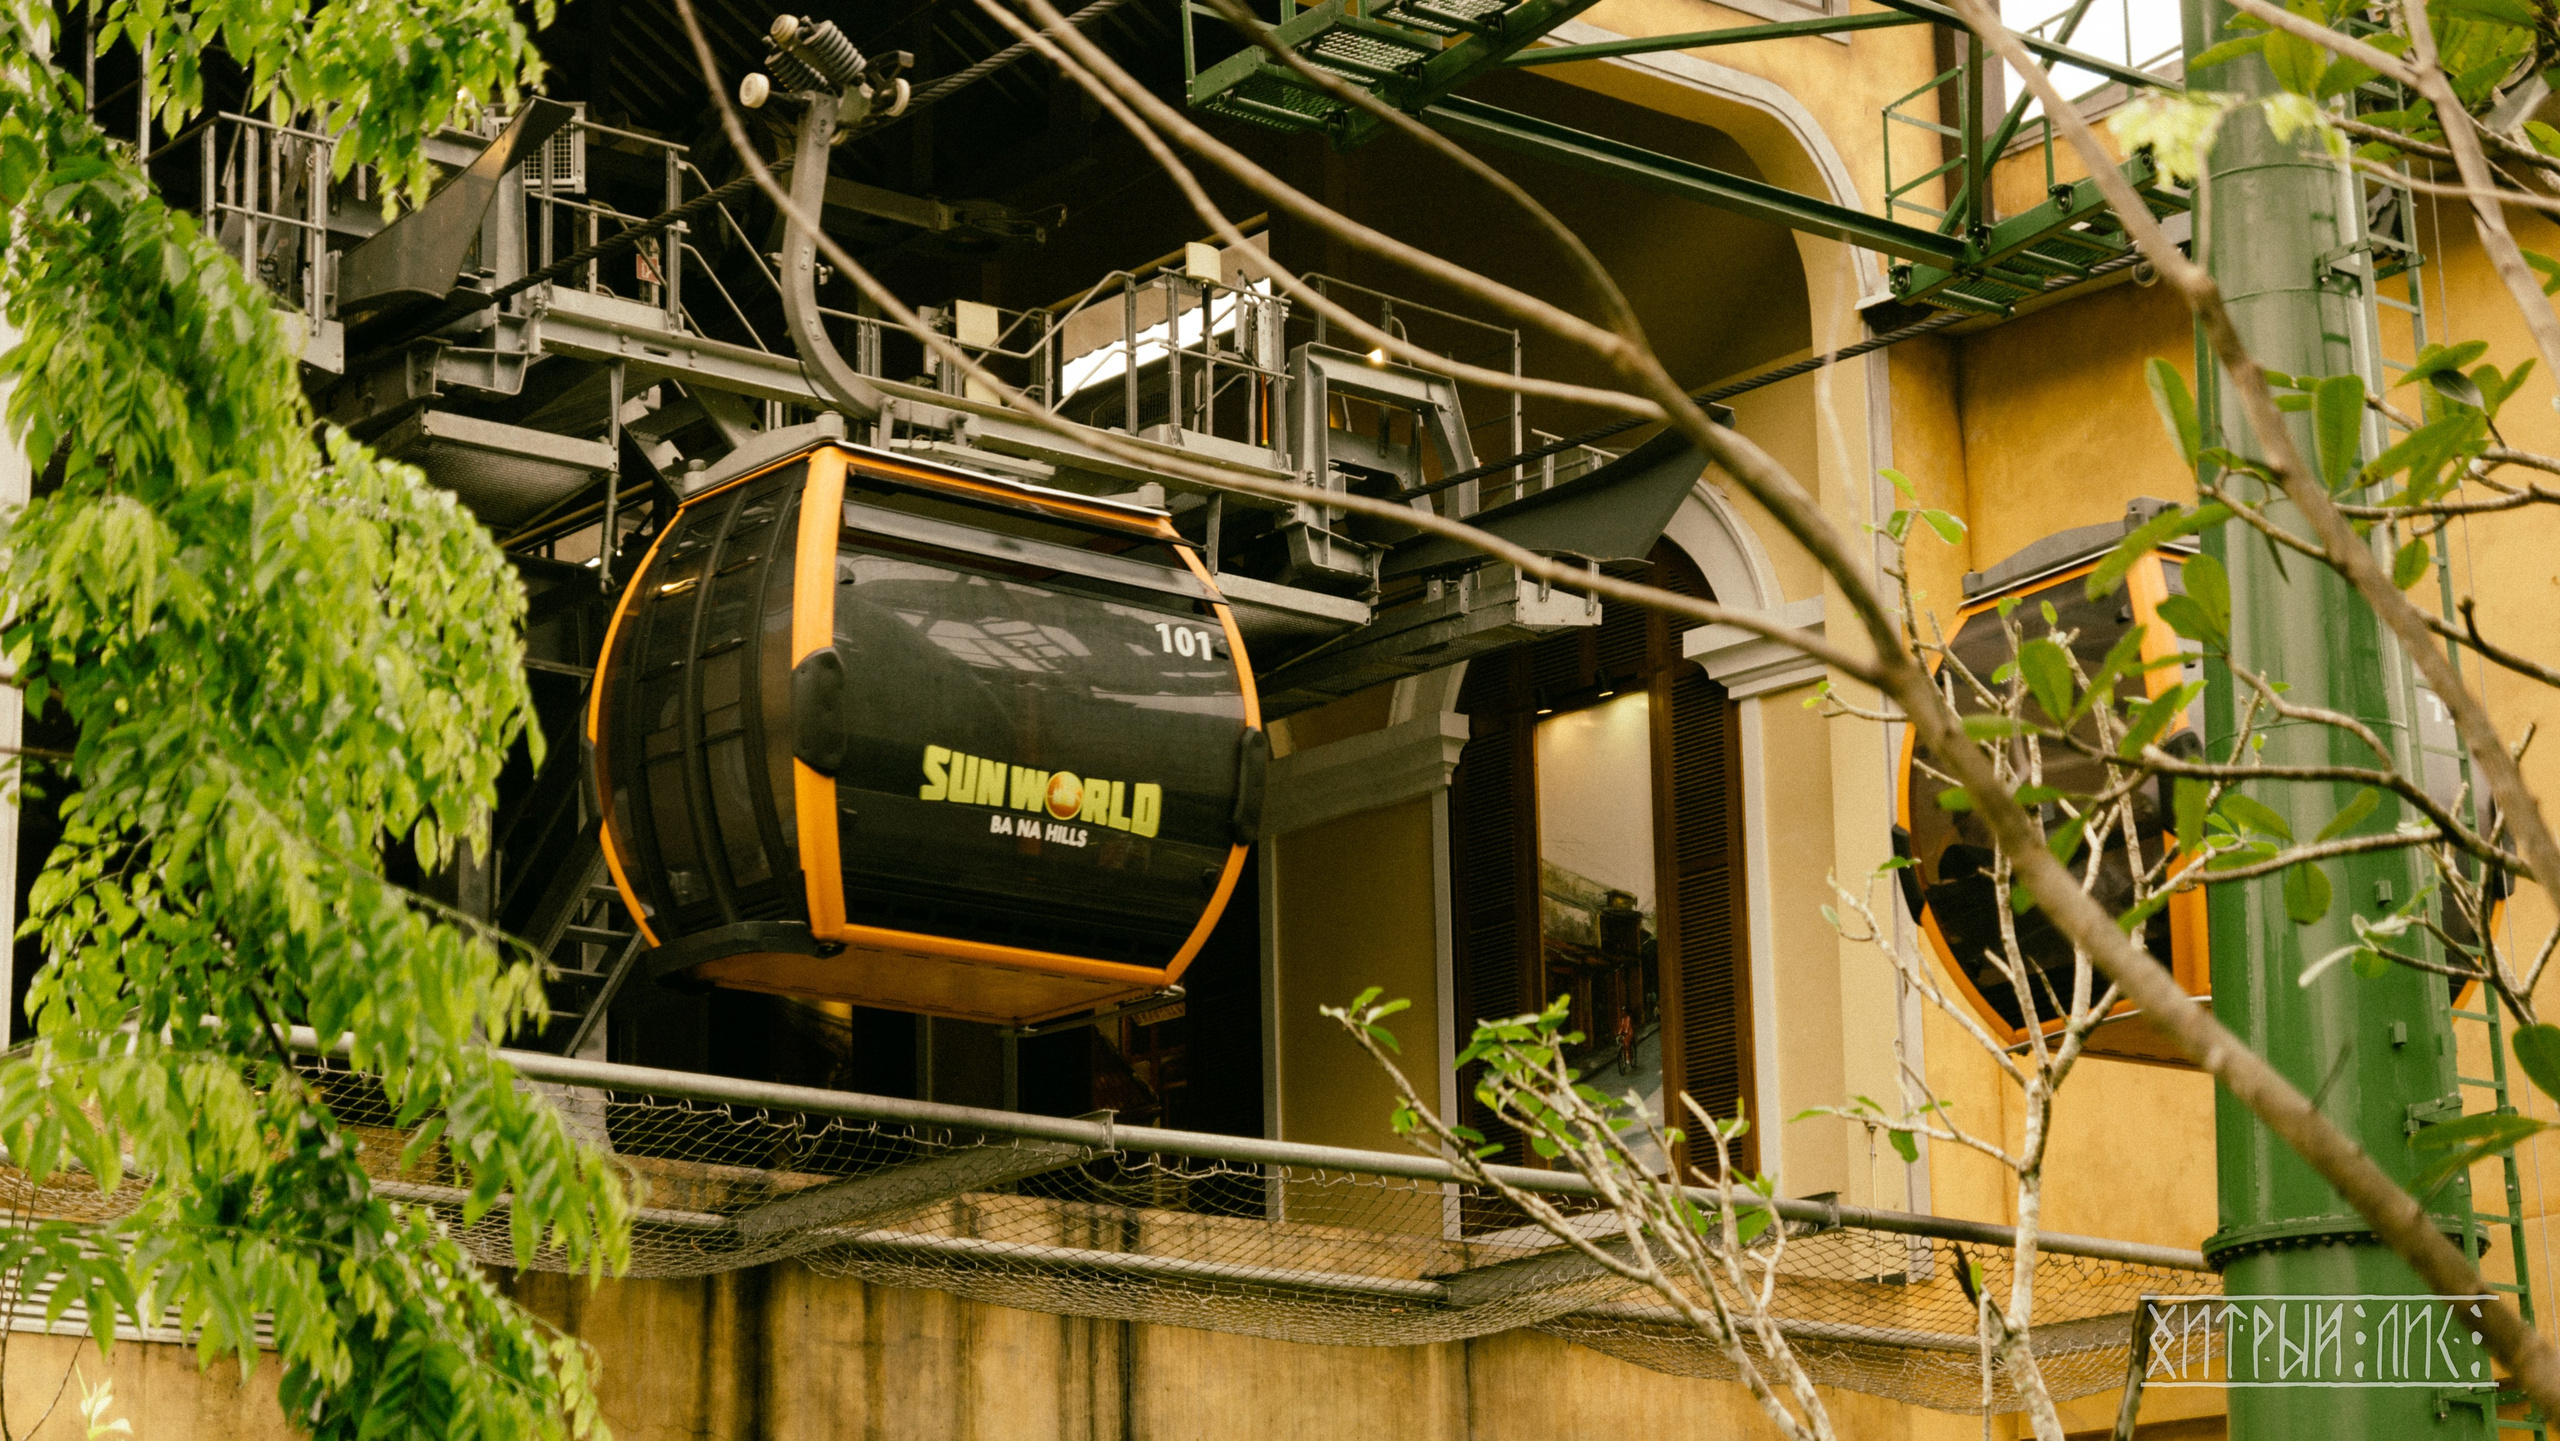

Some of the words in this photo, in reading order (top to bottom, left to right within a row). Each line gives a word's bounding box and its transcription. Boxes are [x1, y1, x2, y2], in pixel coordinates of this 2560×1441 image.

[1155, 623, 1213, 661] 101
[919, 744, 1008, 807] SUN
[1009, 765, 1163, 839] WORLD
[990, 815, 1013, 836] BA
[1016, 818, 1042, 841] NA
[1045, 823, 1089, 848] HILLS
